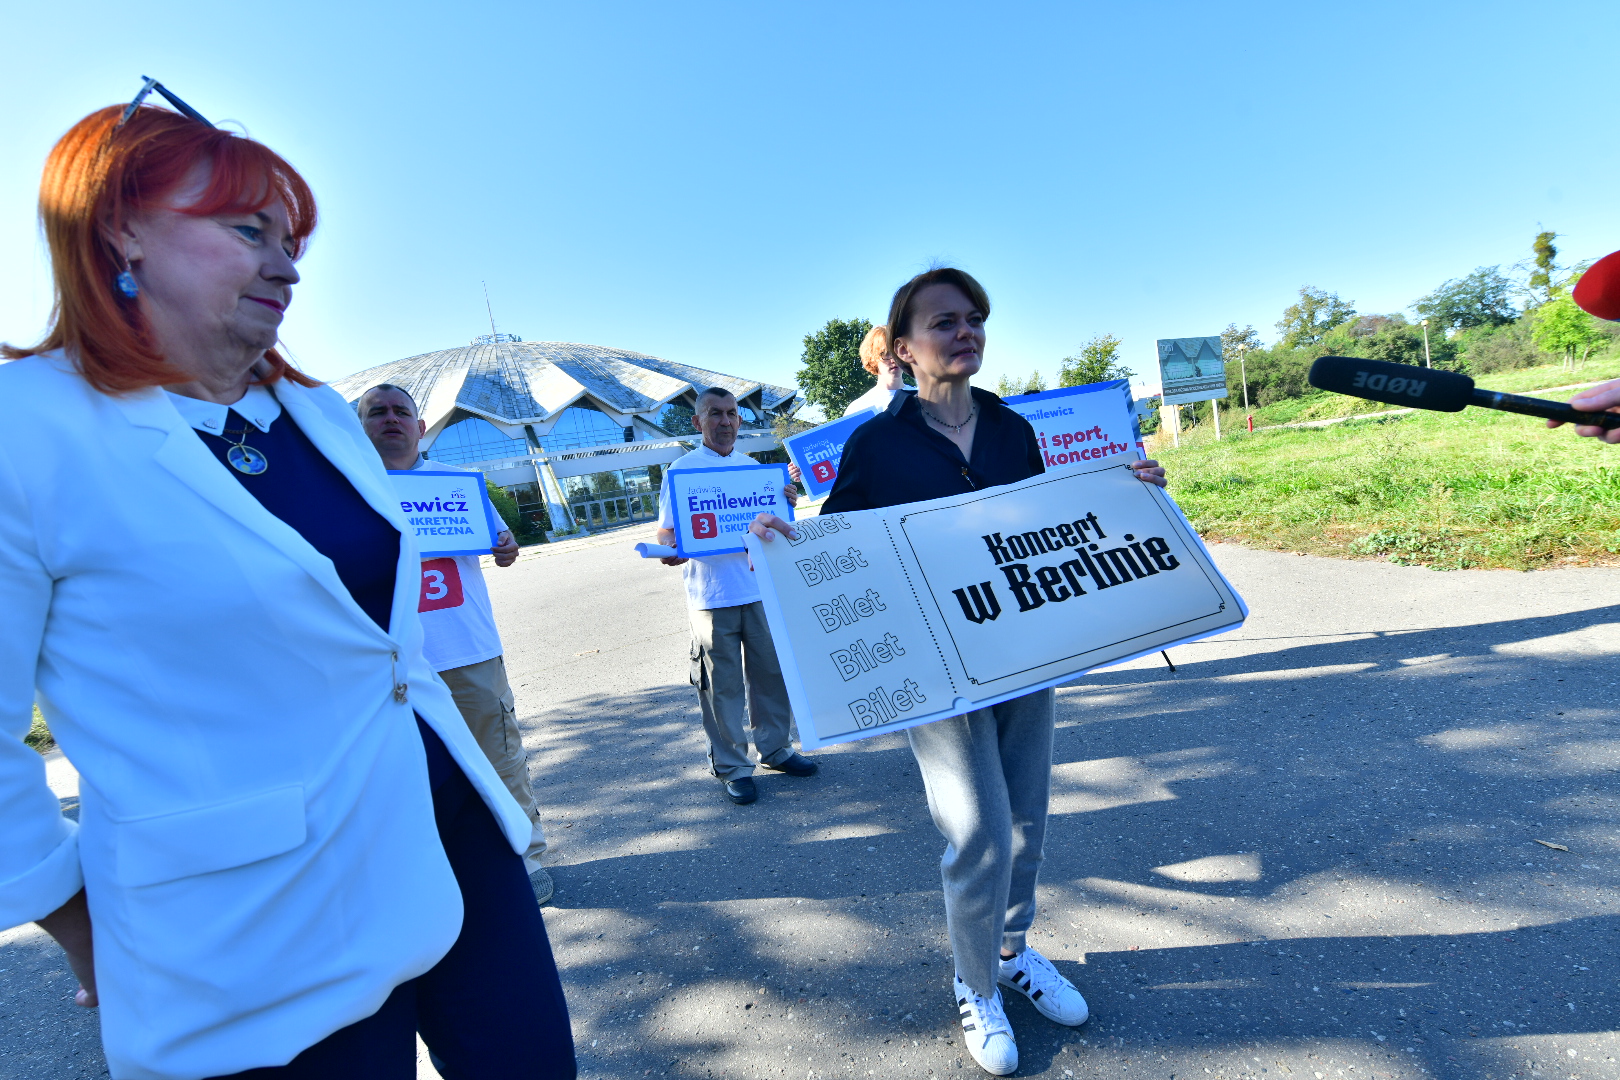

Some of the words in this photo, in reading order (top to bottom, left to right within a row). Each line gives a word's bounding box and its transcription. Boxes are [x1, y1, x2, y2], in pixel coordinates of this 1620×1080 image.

[1353, 371, 1427, 397] RØDE
[803, 441, 846, 465] Emile
[1051, 425, 1109, 450] sport,
[818, 465, 830, 478] 3
[687, 485, 722, 495] Jadwiga
[687, 491, 777, 513] Emilewicz
[699, 518, 711, 534] 3
[785, 514, 851, 547] Bilet
[981, 511, 1107, 565] Koncert
[795, 546, 869, 588] Bilet
[951, 581, 1002, 624] w
[1000, 533, 1180, 613] Berlinie
[423, 569, 449, 600] 3
[811, 588, 887, 634] Bilet
[829, 632, 906, 682] Bilet
[847, 678, 927, 731] Bilet
